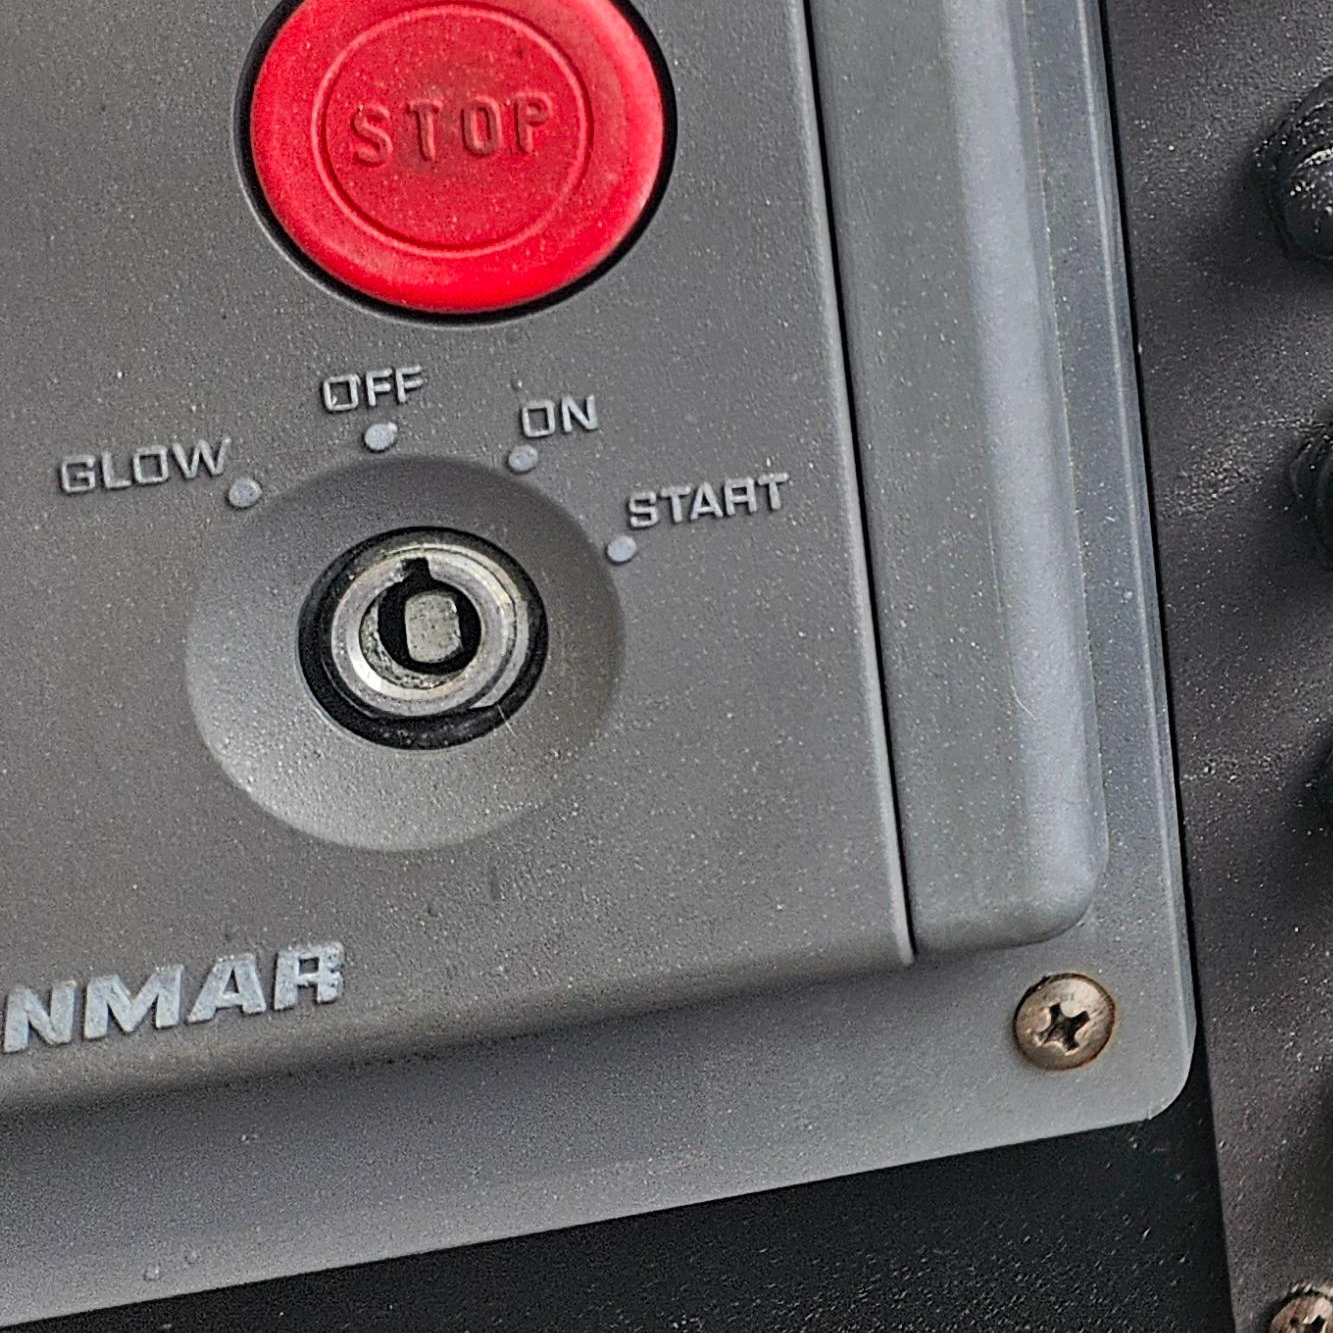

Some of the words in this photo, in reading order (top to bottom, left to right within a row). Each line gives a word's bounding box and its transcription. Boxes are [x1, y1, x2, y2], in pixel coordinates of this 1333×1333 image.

[350, 93, 557, 167] STOP
[322, 366, 424, 411] OFF
[522, 396, 598, 438] ON
[60, 438, 234, 495] GLOW
[629, 474, 789, 530] START
